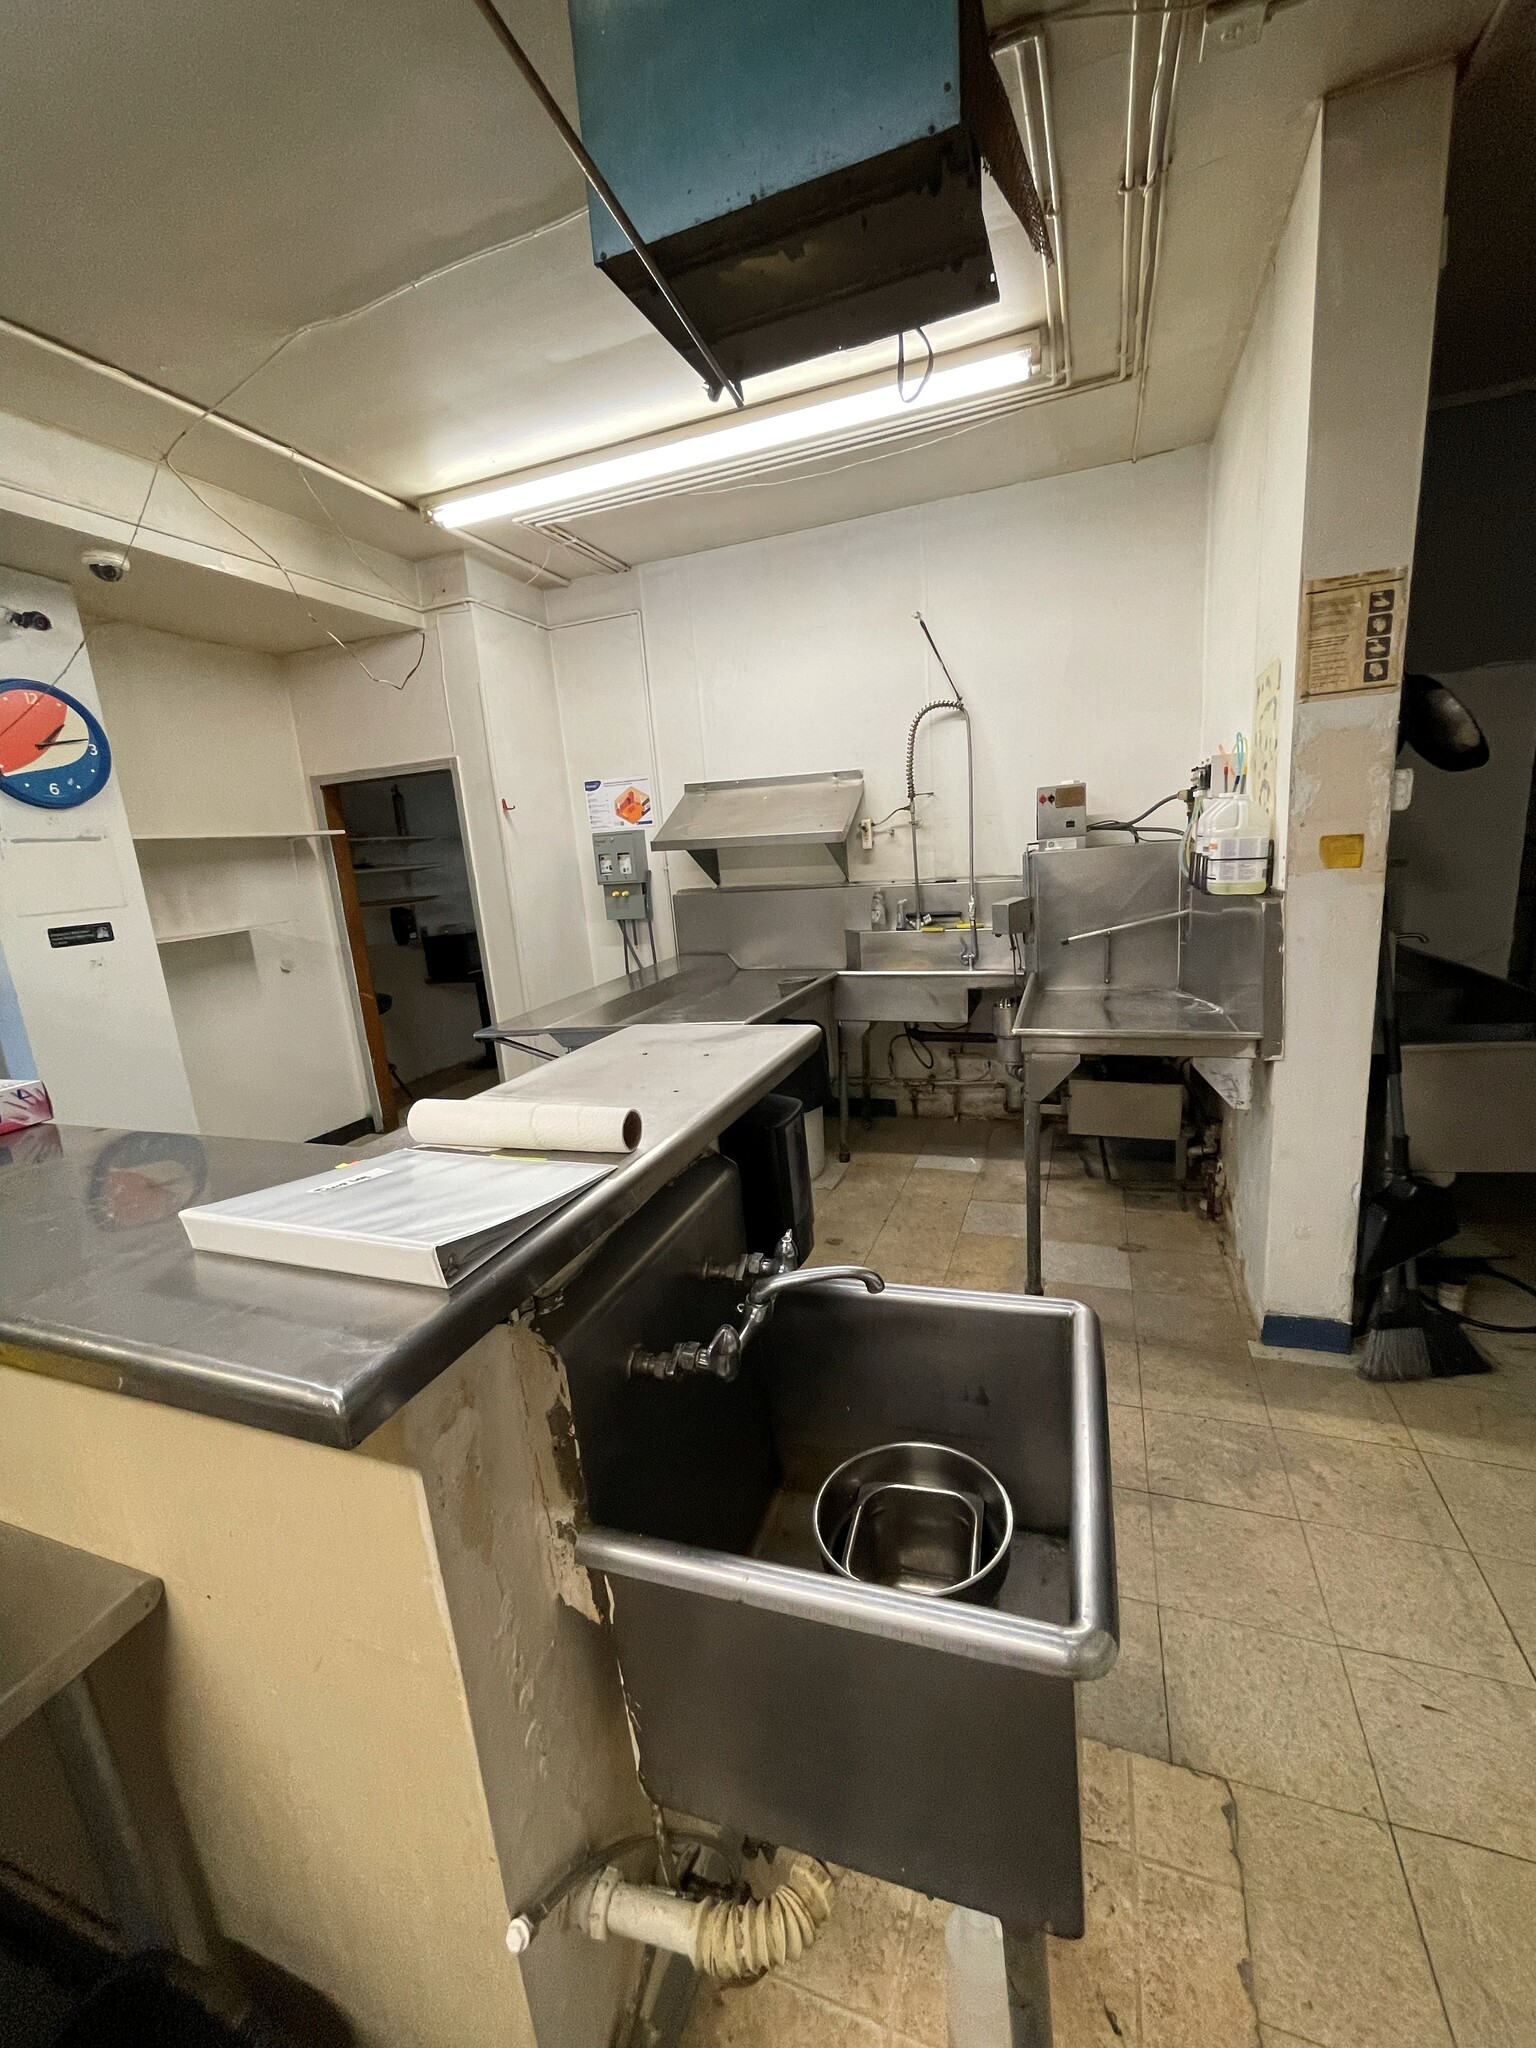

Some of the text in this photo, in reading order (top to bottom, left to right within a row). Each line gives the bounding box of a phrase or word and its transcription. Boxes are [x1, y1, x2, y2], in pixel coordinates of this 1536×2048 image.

[23, 692, 41, 706] 12
[88, 743, 98, 756] 3
[49, 782, 60, 795] 6
